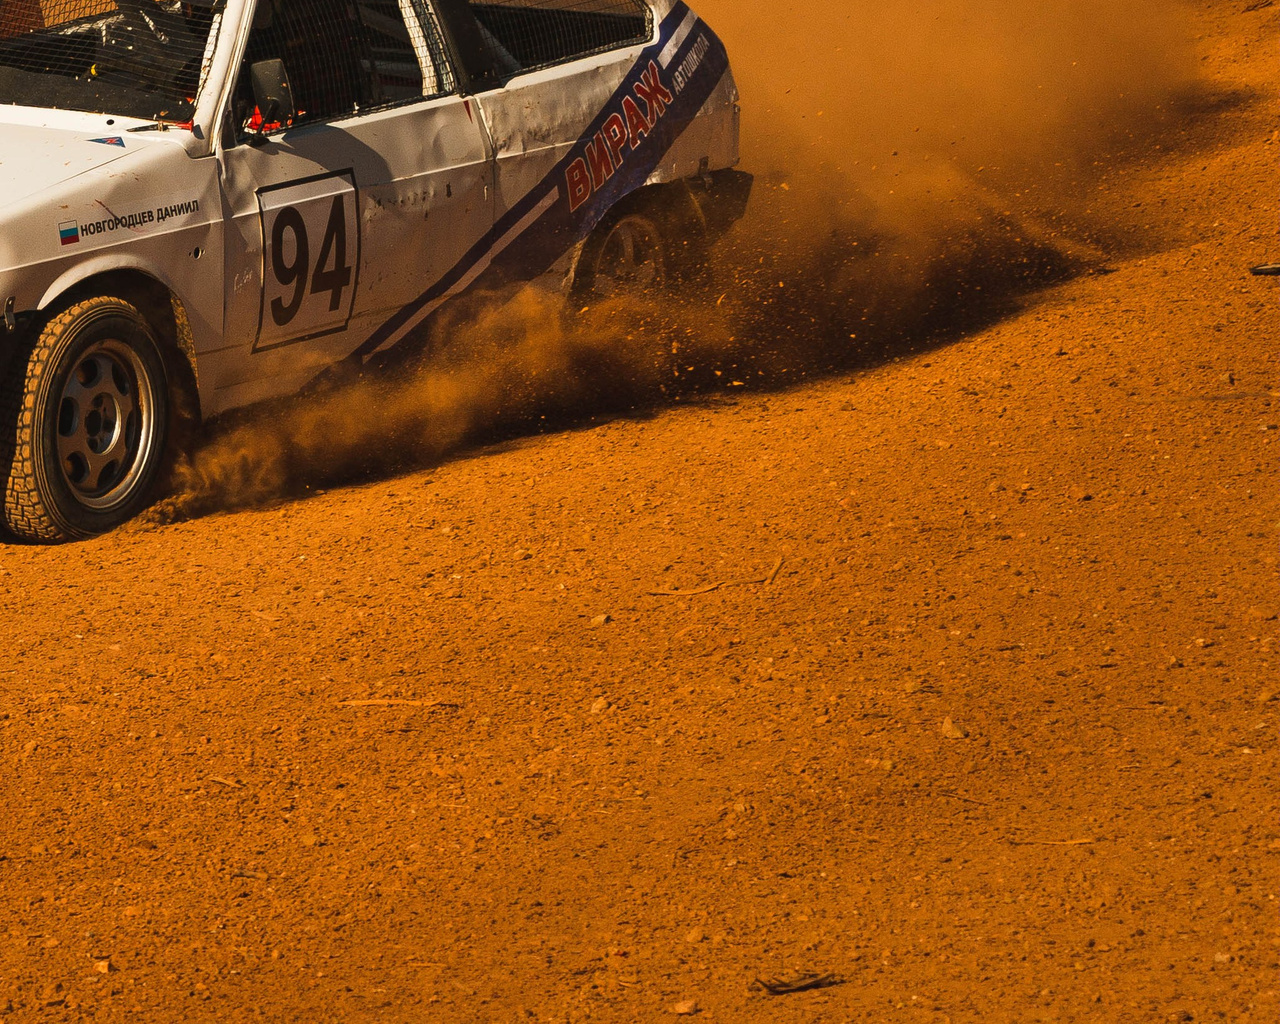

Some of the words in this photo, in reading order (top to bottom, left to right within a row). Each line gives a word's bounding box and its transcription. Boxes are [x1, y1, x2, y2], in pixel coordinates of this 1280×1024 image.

[565, 59, 673, 213] ВИРАЖ
[80, 210, 154, 236] НОВГОРОДЦЕВ
[157, 199, 200, 222] ДАНИИЛ
[270, 195, 352, 326] 94
